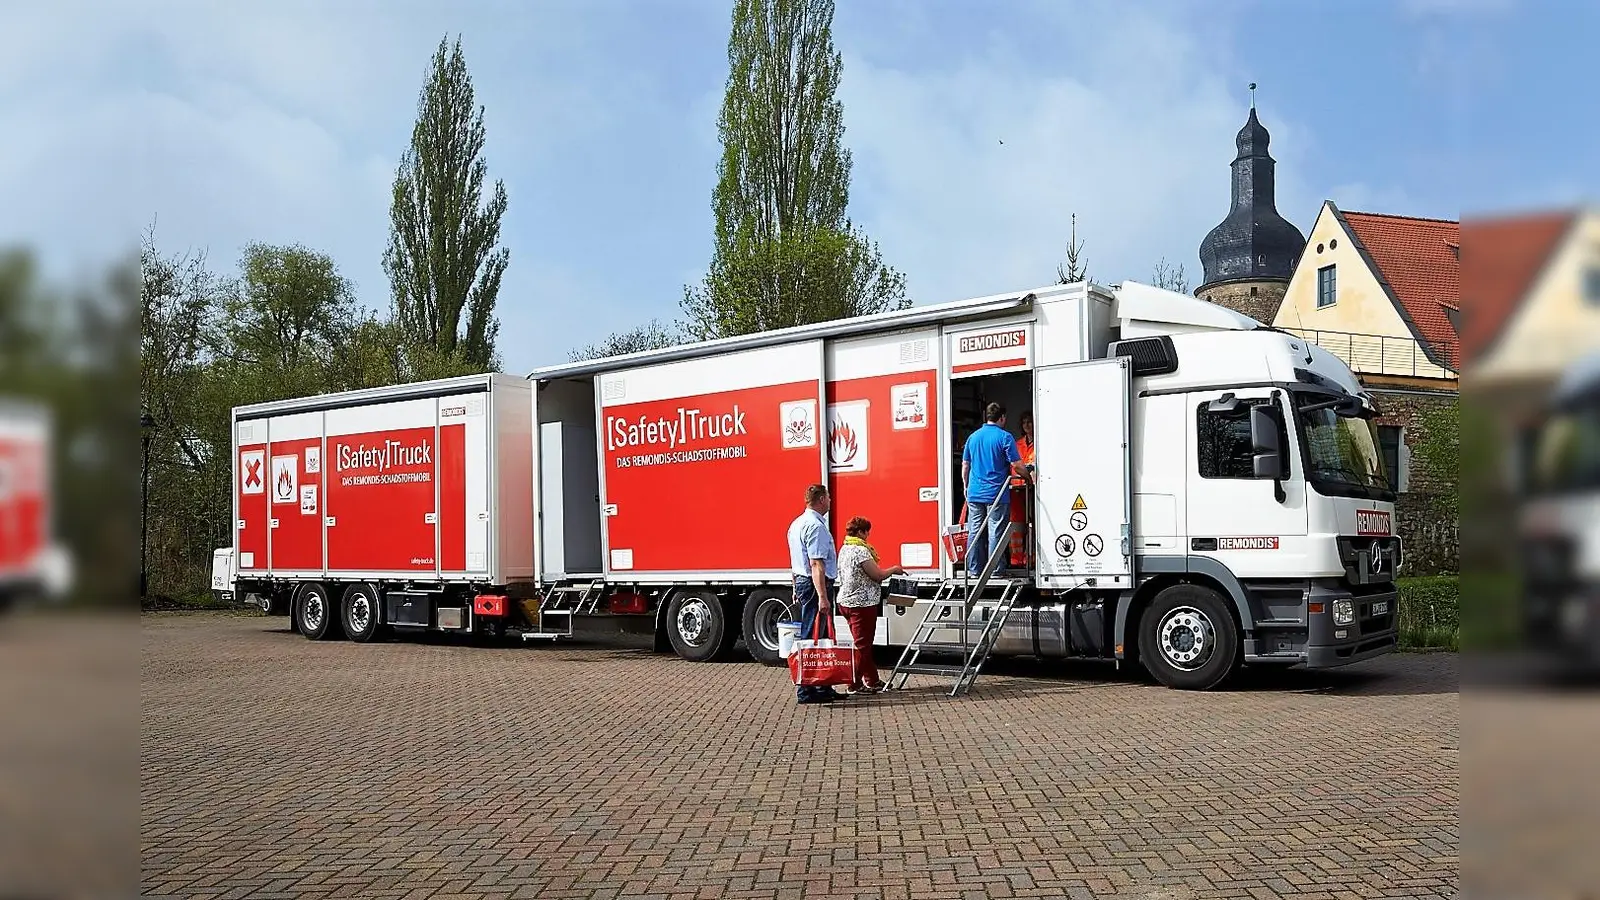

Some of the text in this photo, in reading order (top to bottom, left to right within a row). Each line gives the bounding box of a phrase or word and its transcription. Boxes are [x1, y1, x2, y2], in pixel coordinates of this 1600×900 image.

[961, 332, 1020, 352] REMONDIS
[616, 446, 747, 468] DAS REMONDIS-SCHADSTOFFMOBIL
[342, 476, 353, 486] DAS
[1357, 513, 1390, 533] REMONDIS
[1220, 537, 1274, 549] REMONDIS
